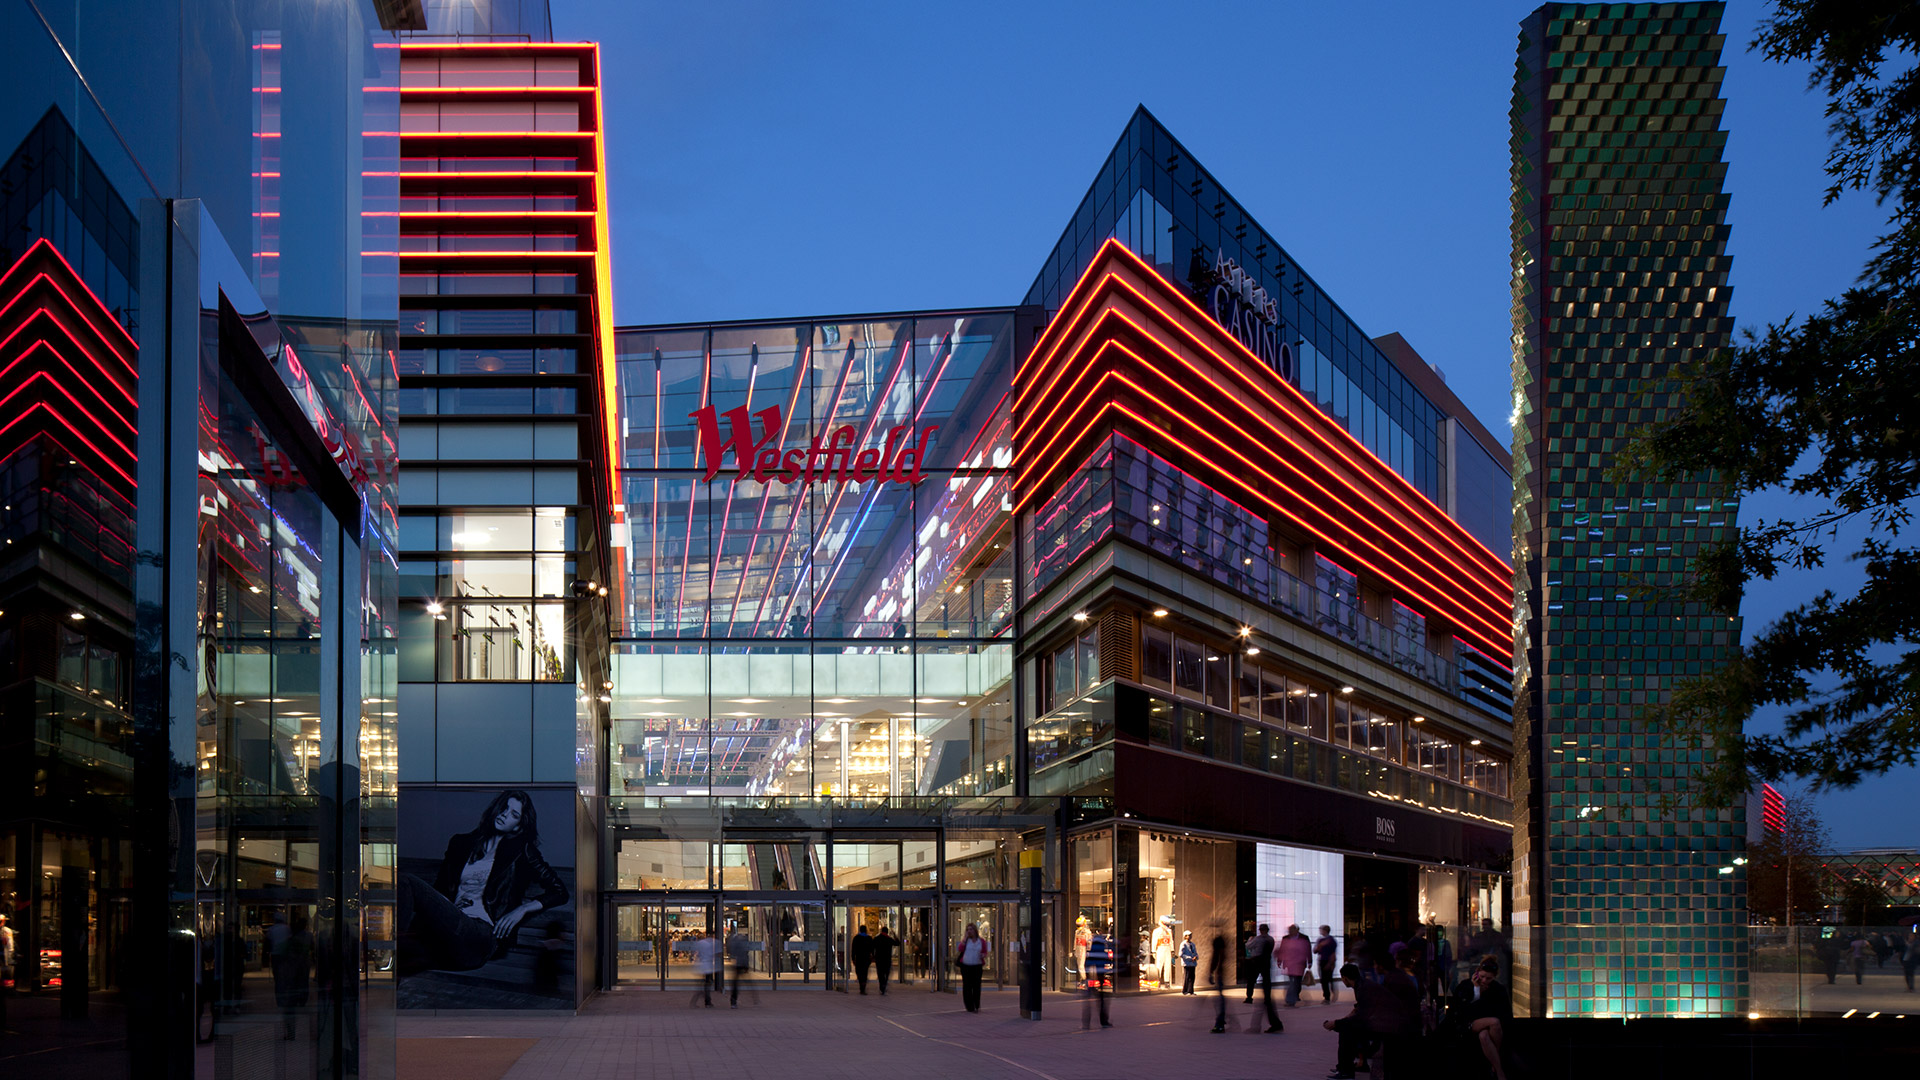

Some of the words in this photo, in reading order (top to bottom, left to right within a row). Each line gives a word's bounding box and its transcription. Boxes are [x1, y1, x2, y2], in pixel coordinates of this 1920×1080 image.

[1213, 284, 1294, 384] CASINO
[688, 404, 940, 484] Westfield
[1376, 817, 1396, 837] BOSS
